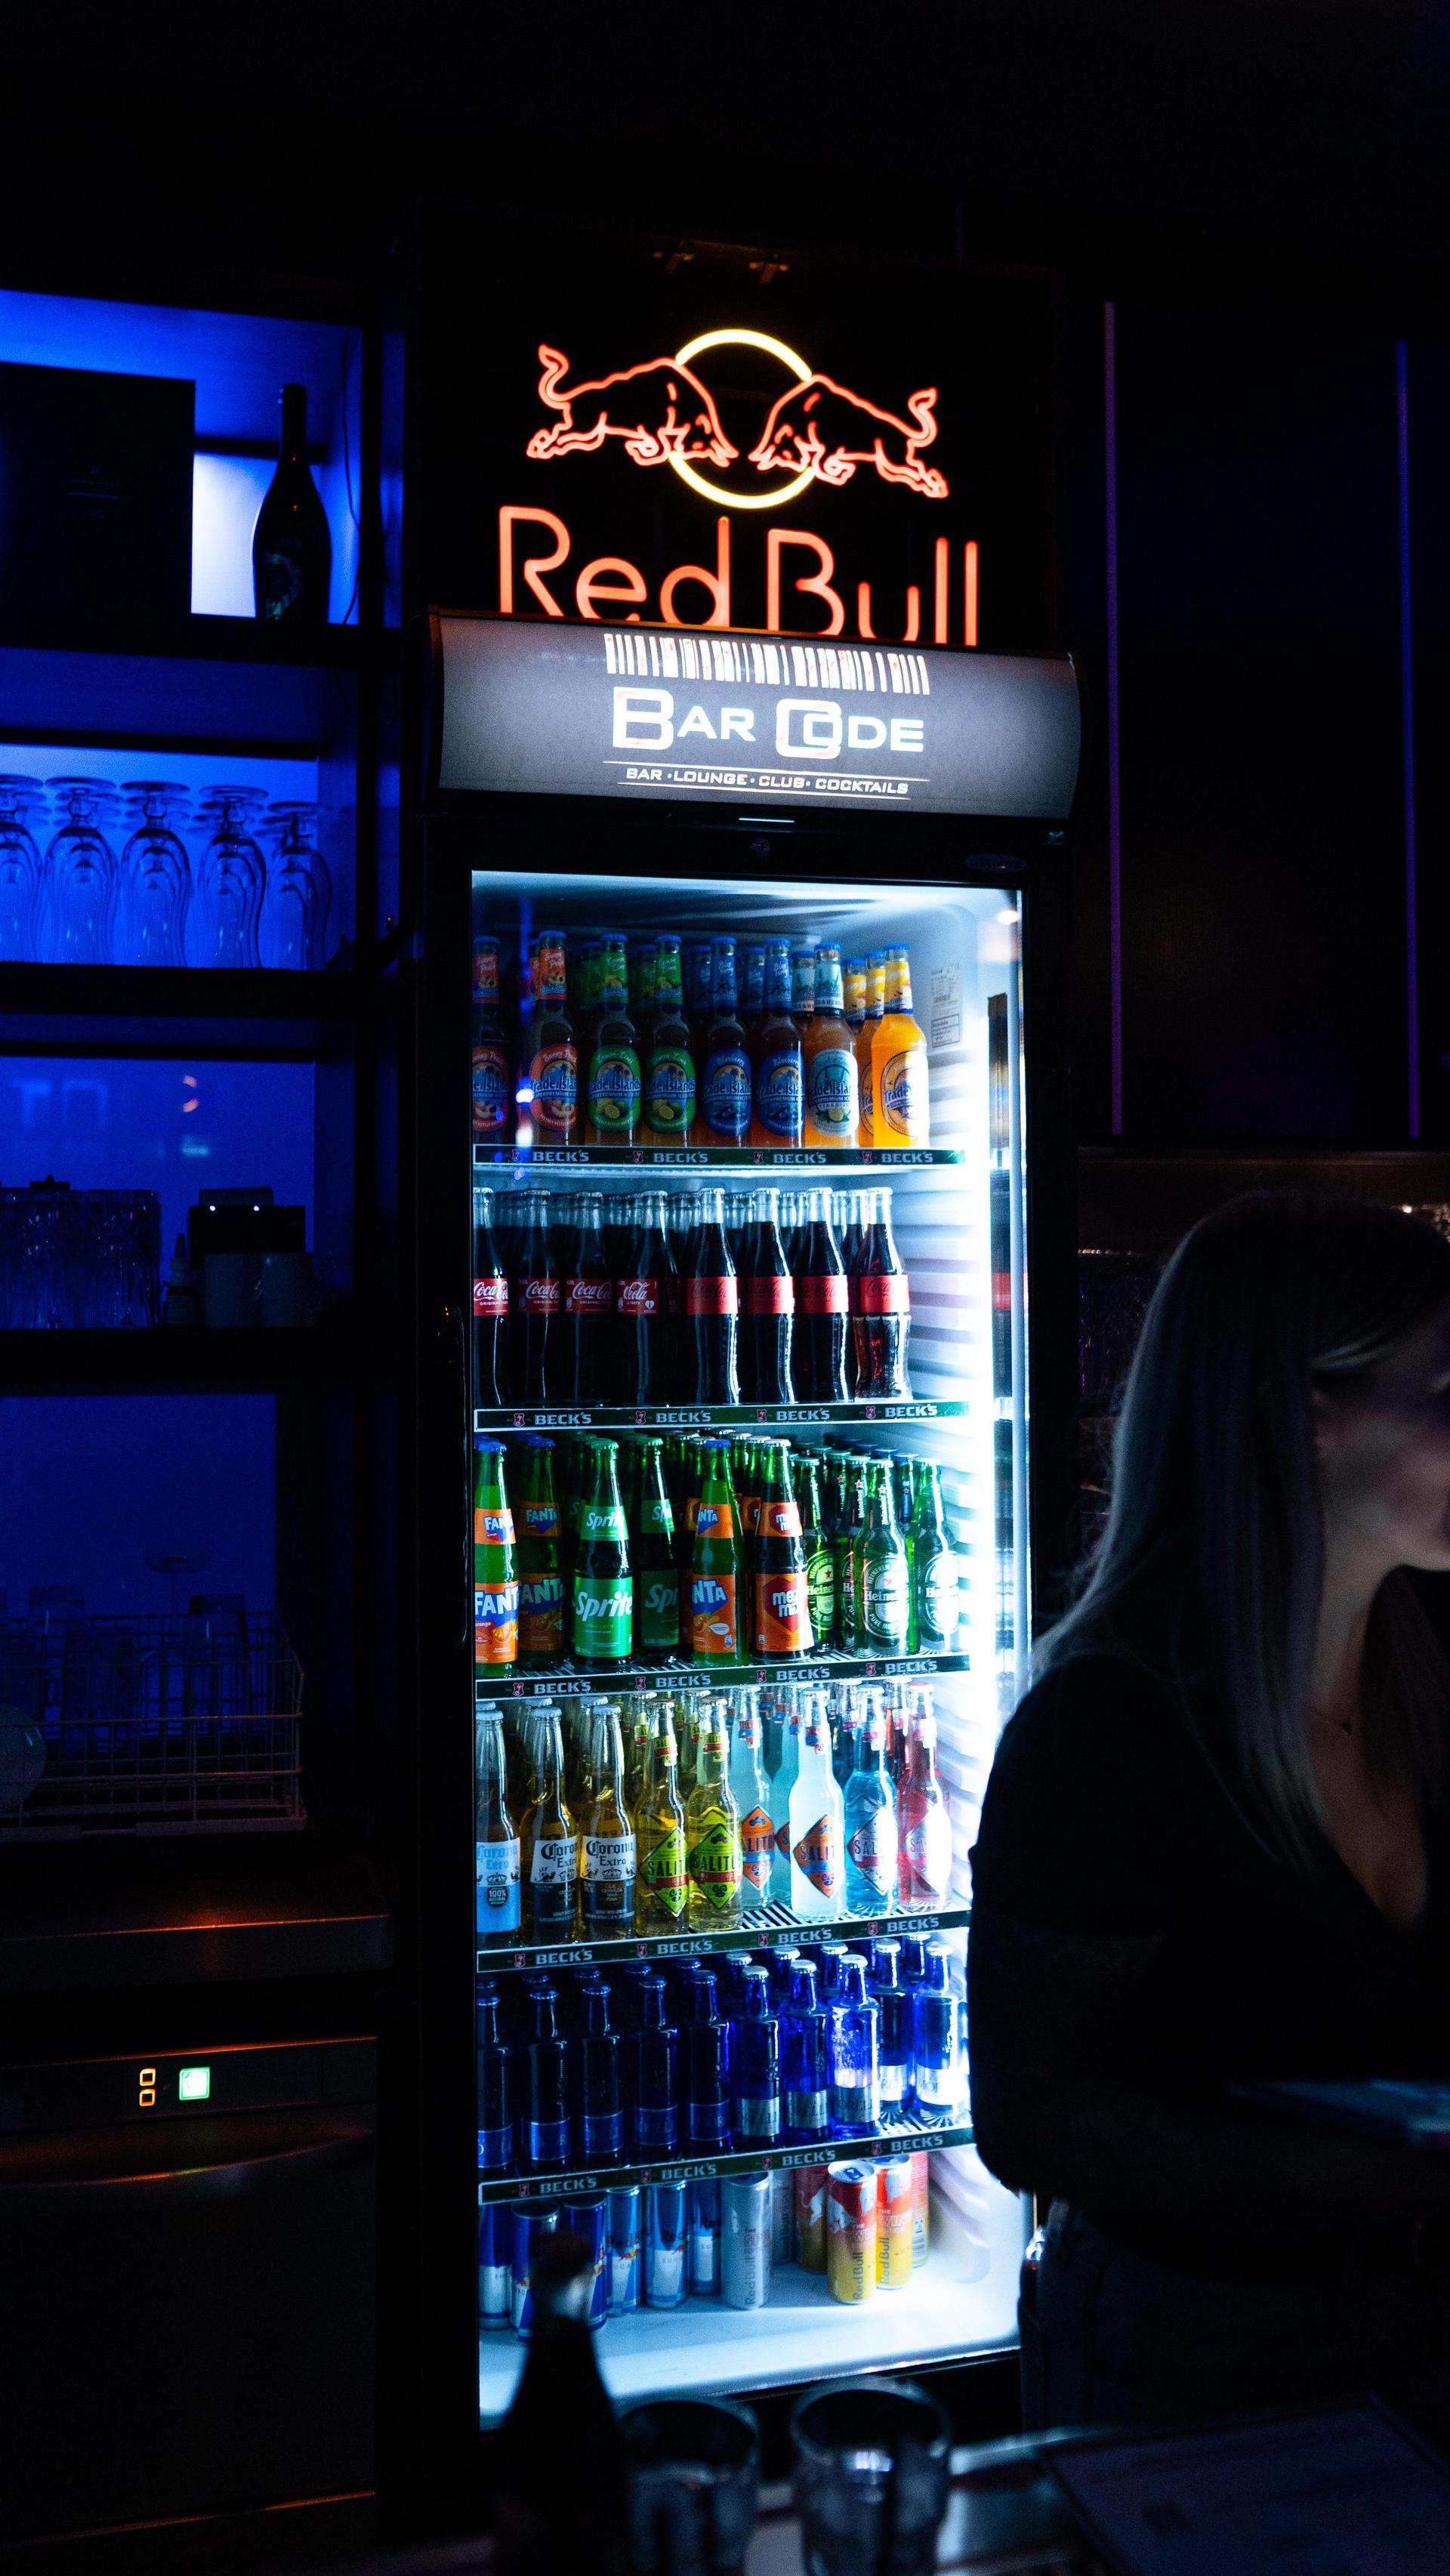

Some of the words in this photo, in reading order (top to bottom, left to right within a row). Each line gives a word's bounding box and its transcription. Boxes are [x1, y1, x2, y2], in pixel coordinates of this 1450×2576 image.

[498, 505, 731, 628] Red
[767, 529, 979, 647] Bull
[626, 768, 662, 781] BAR
[674, 770, 748, 785] LOUNGE
[758, 776, 805, 789] CLUB
[815, 779, 909, 794] COCKTAILS
[532, 1150, 589, 1163] BECK'S
[653, 1150, 708, 1164] BECK'S
[773, 1151, 826, 1164] BECK'S
[881, 1150, 933, 1164] BECK'S
[474, 1281, 508, 1300] Coca-Co
[535, 1411, 591, 1425] BECK'S
[656, 1410, 711, 1424] BECK'S
[776, 1408, 830, 1421] BECK'S
[885, 1403, 938, 1418] BECK'S
[698, 1507, 718, 1522] NTA
[692, 1579, 727, 1604] NTA
[475, 1585, 520, 1617] FANT
[776, 1664, 830, 1681] BECK'S
[885, 1659, 937, 1674] BECK'S
[534, 1678, 591, 1695] BECK'S
[656, 1672, 711, 1688] BECK'S
[541, 1842, 575, 1862] Coro
[586, 1840, 634, 1859] Corona
[557, 1857, 575, 1868] Extr
[600, 1856, 626, 1866] Extra
[489, 1888, 507, 1897] 100%
[887, 1914, 939, 1933] BECK'S
[779, 1927, 832, 1945] BECK'S
[657, 1939, 712, 1955] BECK'S
[535, 1948, 593, 1965] BECK'S
[890, 2134, 943, 2152] BECK'S
[782, 2148, 836, 2167] BECK'S
[661, 2162, 717, 2180] BECK'S
[539, 2176, 597, 2194] BECK'S
